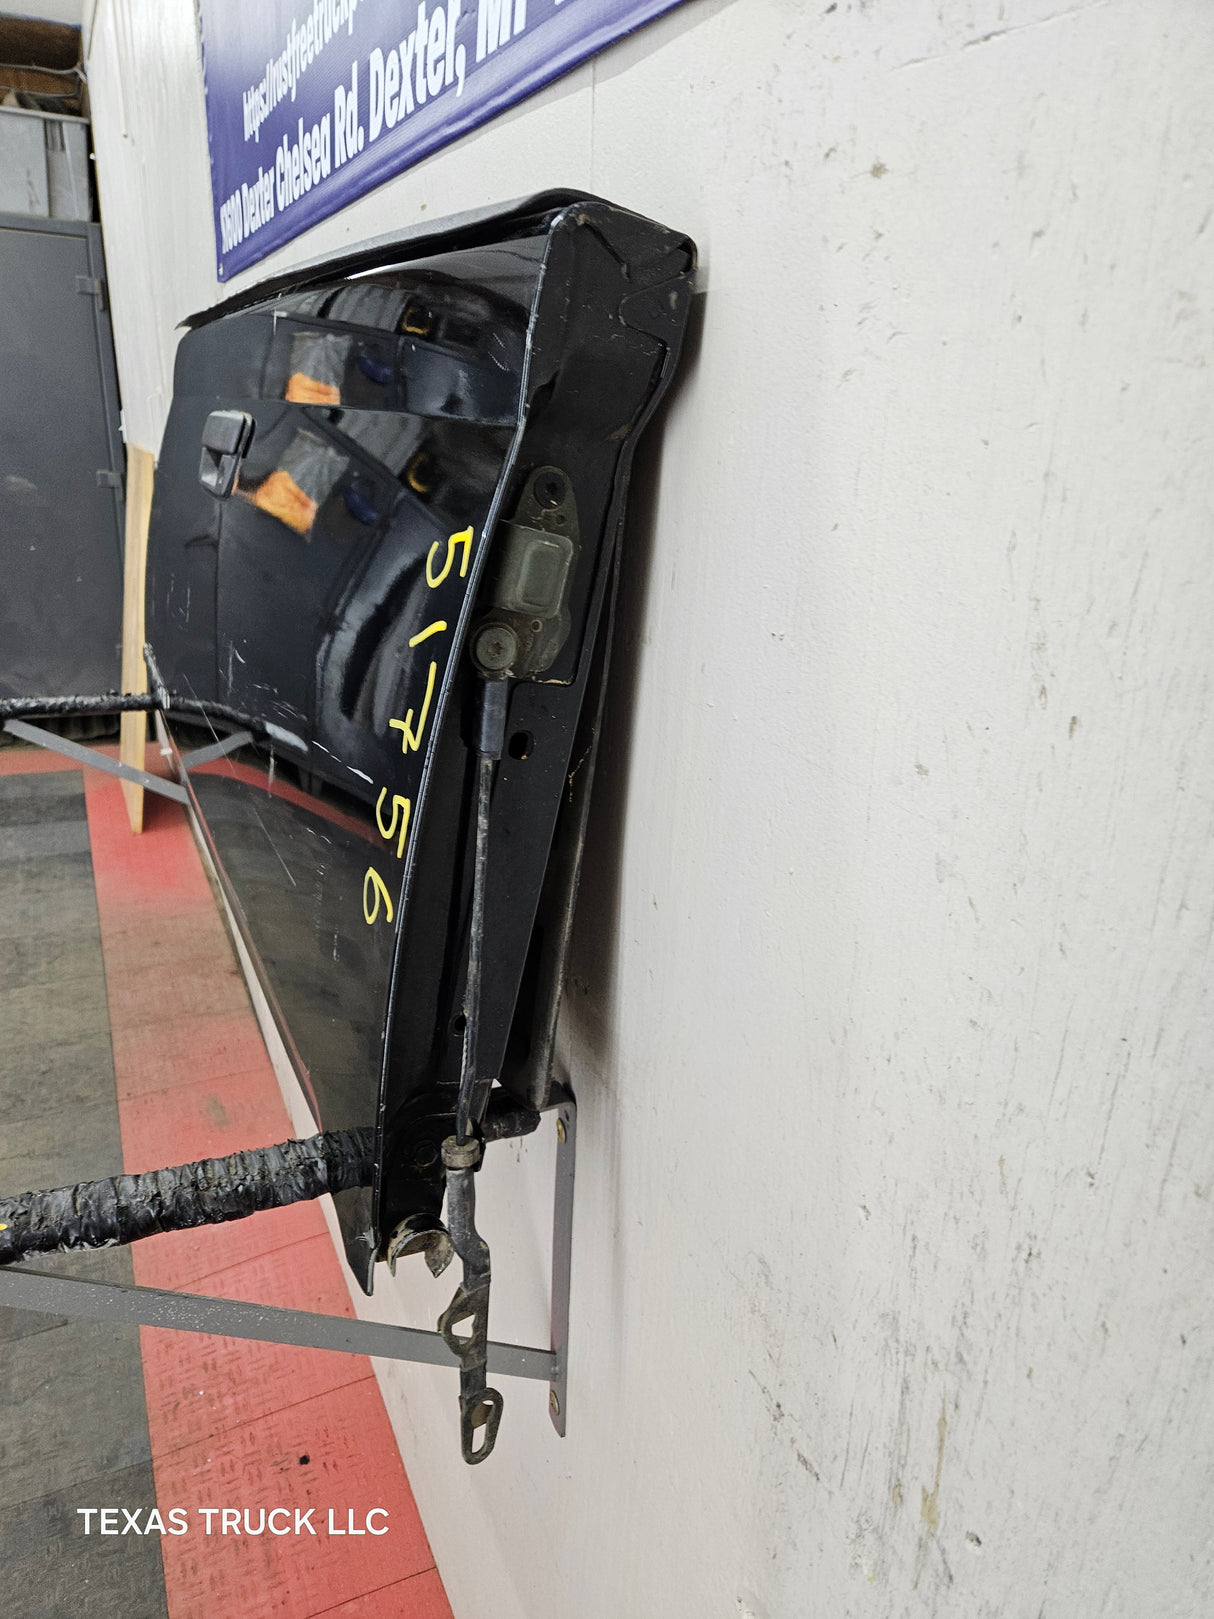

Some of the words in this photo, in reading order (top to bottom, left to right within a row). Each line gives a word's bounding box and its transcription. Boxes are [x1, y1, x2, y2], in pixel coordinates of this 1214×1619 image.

[241, 167, 275, 238] Dexter
[276, 113, 331, 212] Chelsea
[334, 61, 365, 169] Rd.
[369, 0, 466, 142] Dexter,
